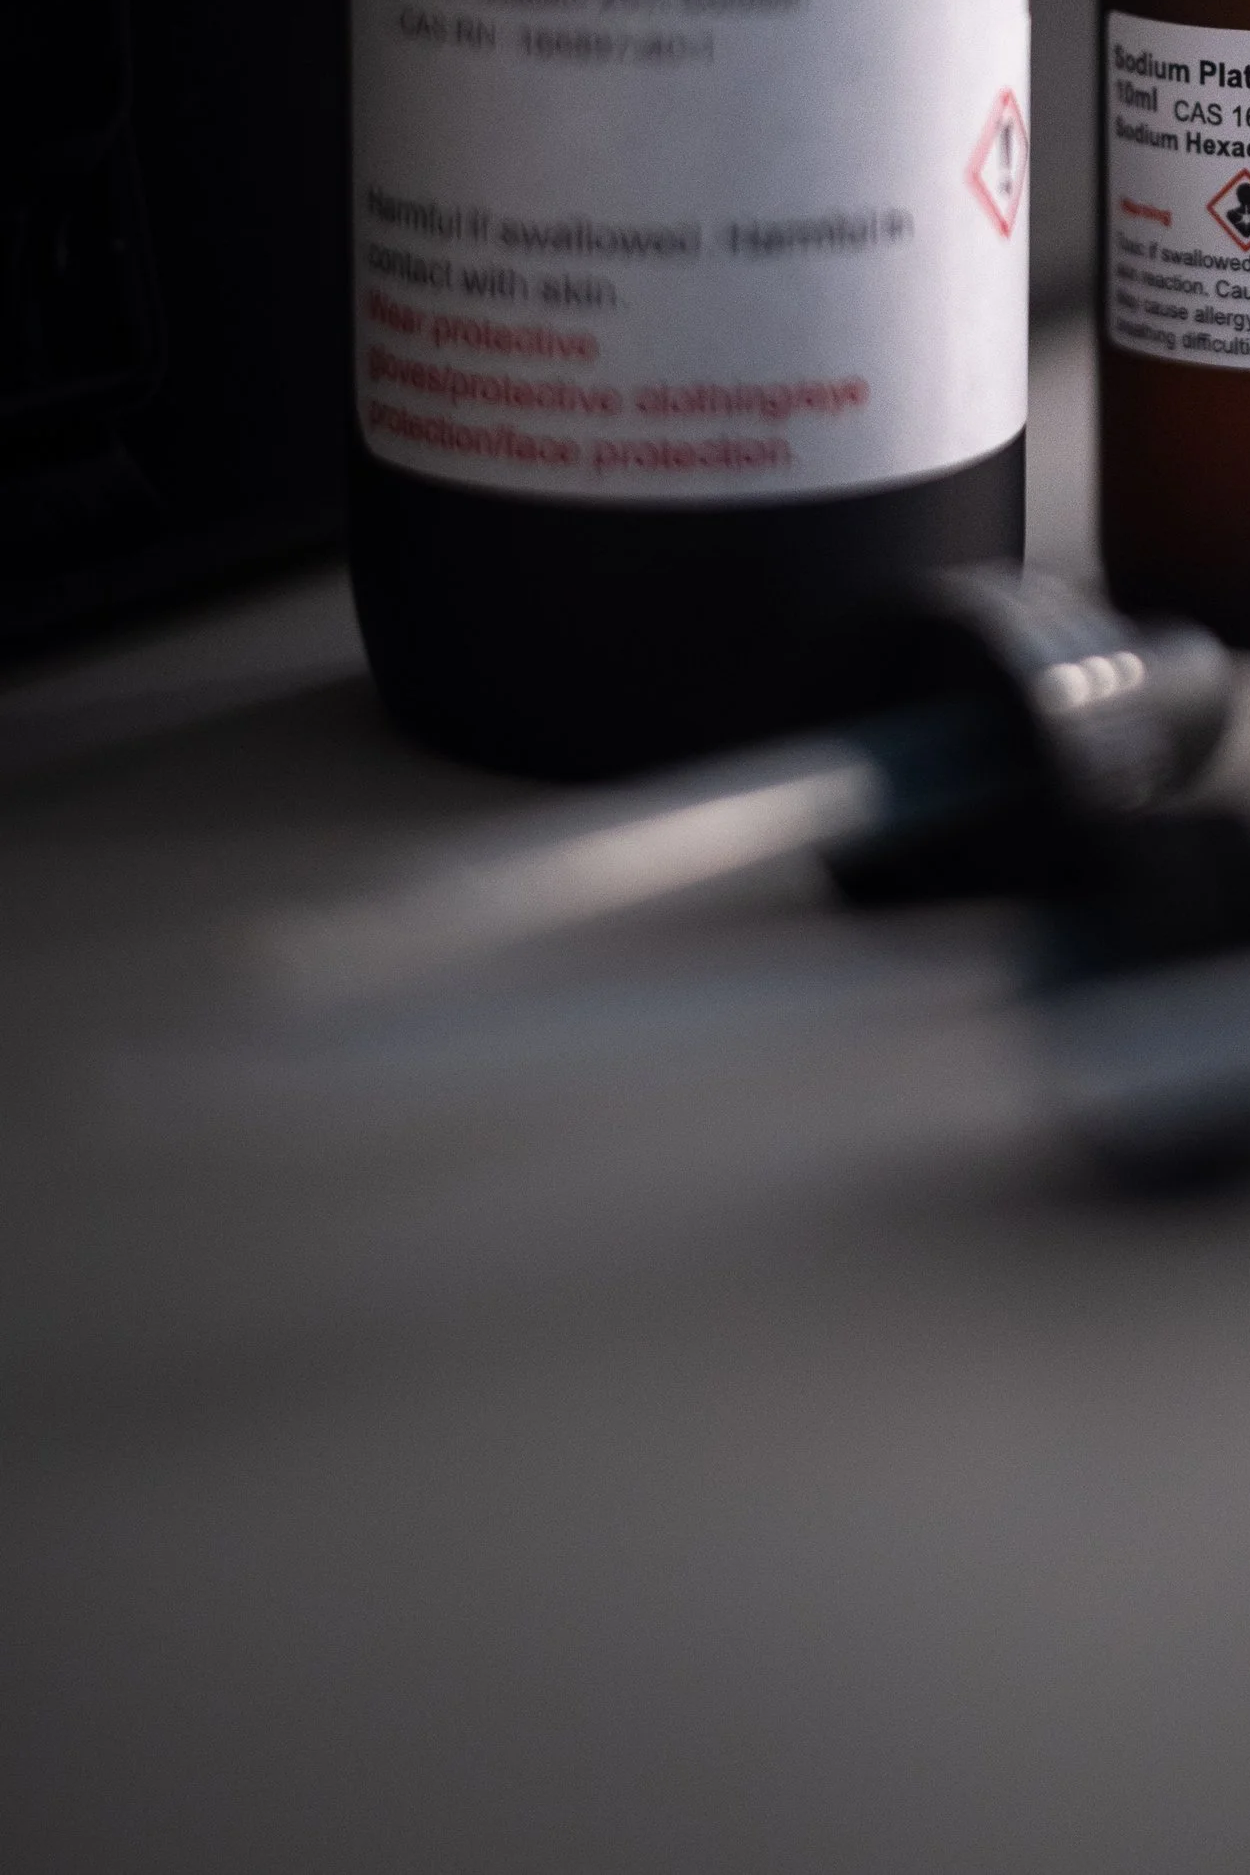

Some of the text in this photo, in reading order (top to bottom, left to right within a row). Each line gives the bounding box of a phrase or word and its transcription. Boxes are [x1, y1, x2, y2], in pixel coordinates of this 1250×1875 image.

[1112, 46, 1190, 84] Sodium
[1116, 81, 1159, 112] 10ml
[1173, 100, 1223, 128] CAS
[1114, 116, 1179, 151] Sodium
[368, 184, 462, 239] Harmful
[368, 238, 454, 289] contact
[461, 250, 524, 296] with
[1142, 270, 1209, 297] reaction.
[1144, 299, 1189, 321] cause
[430, 303, 600, 362] protective
